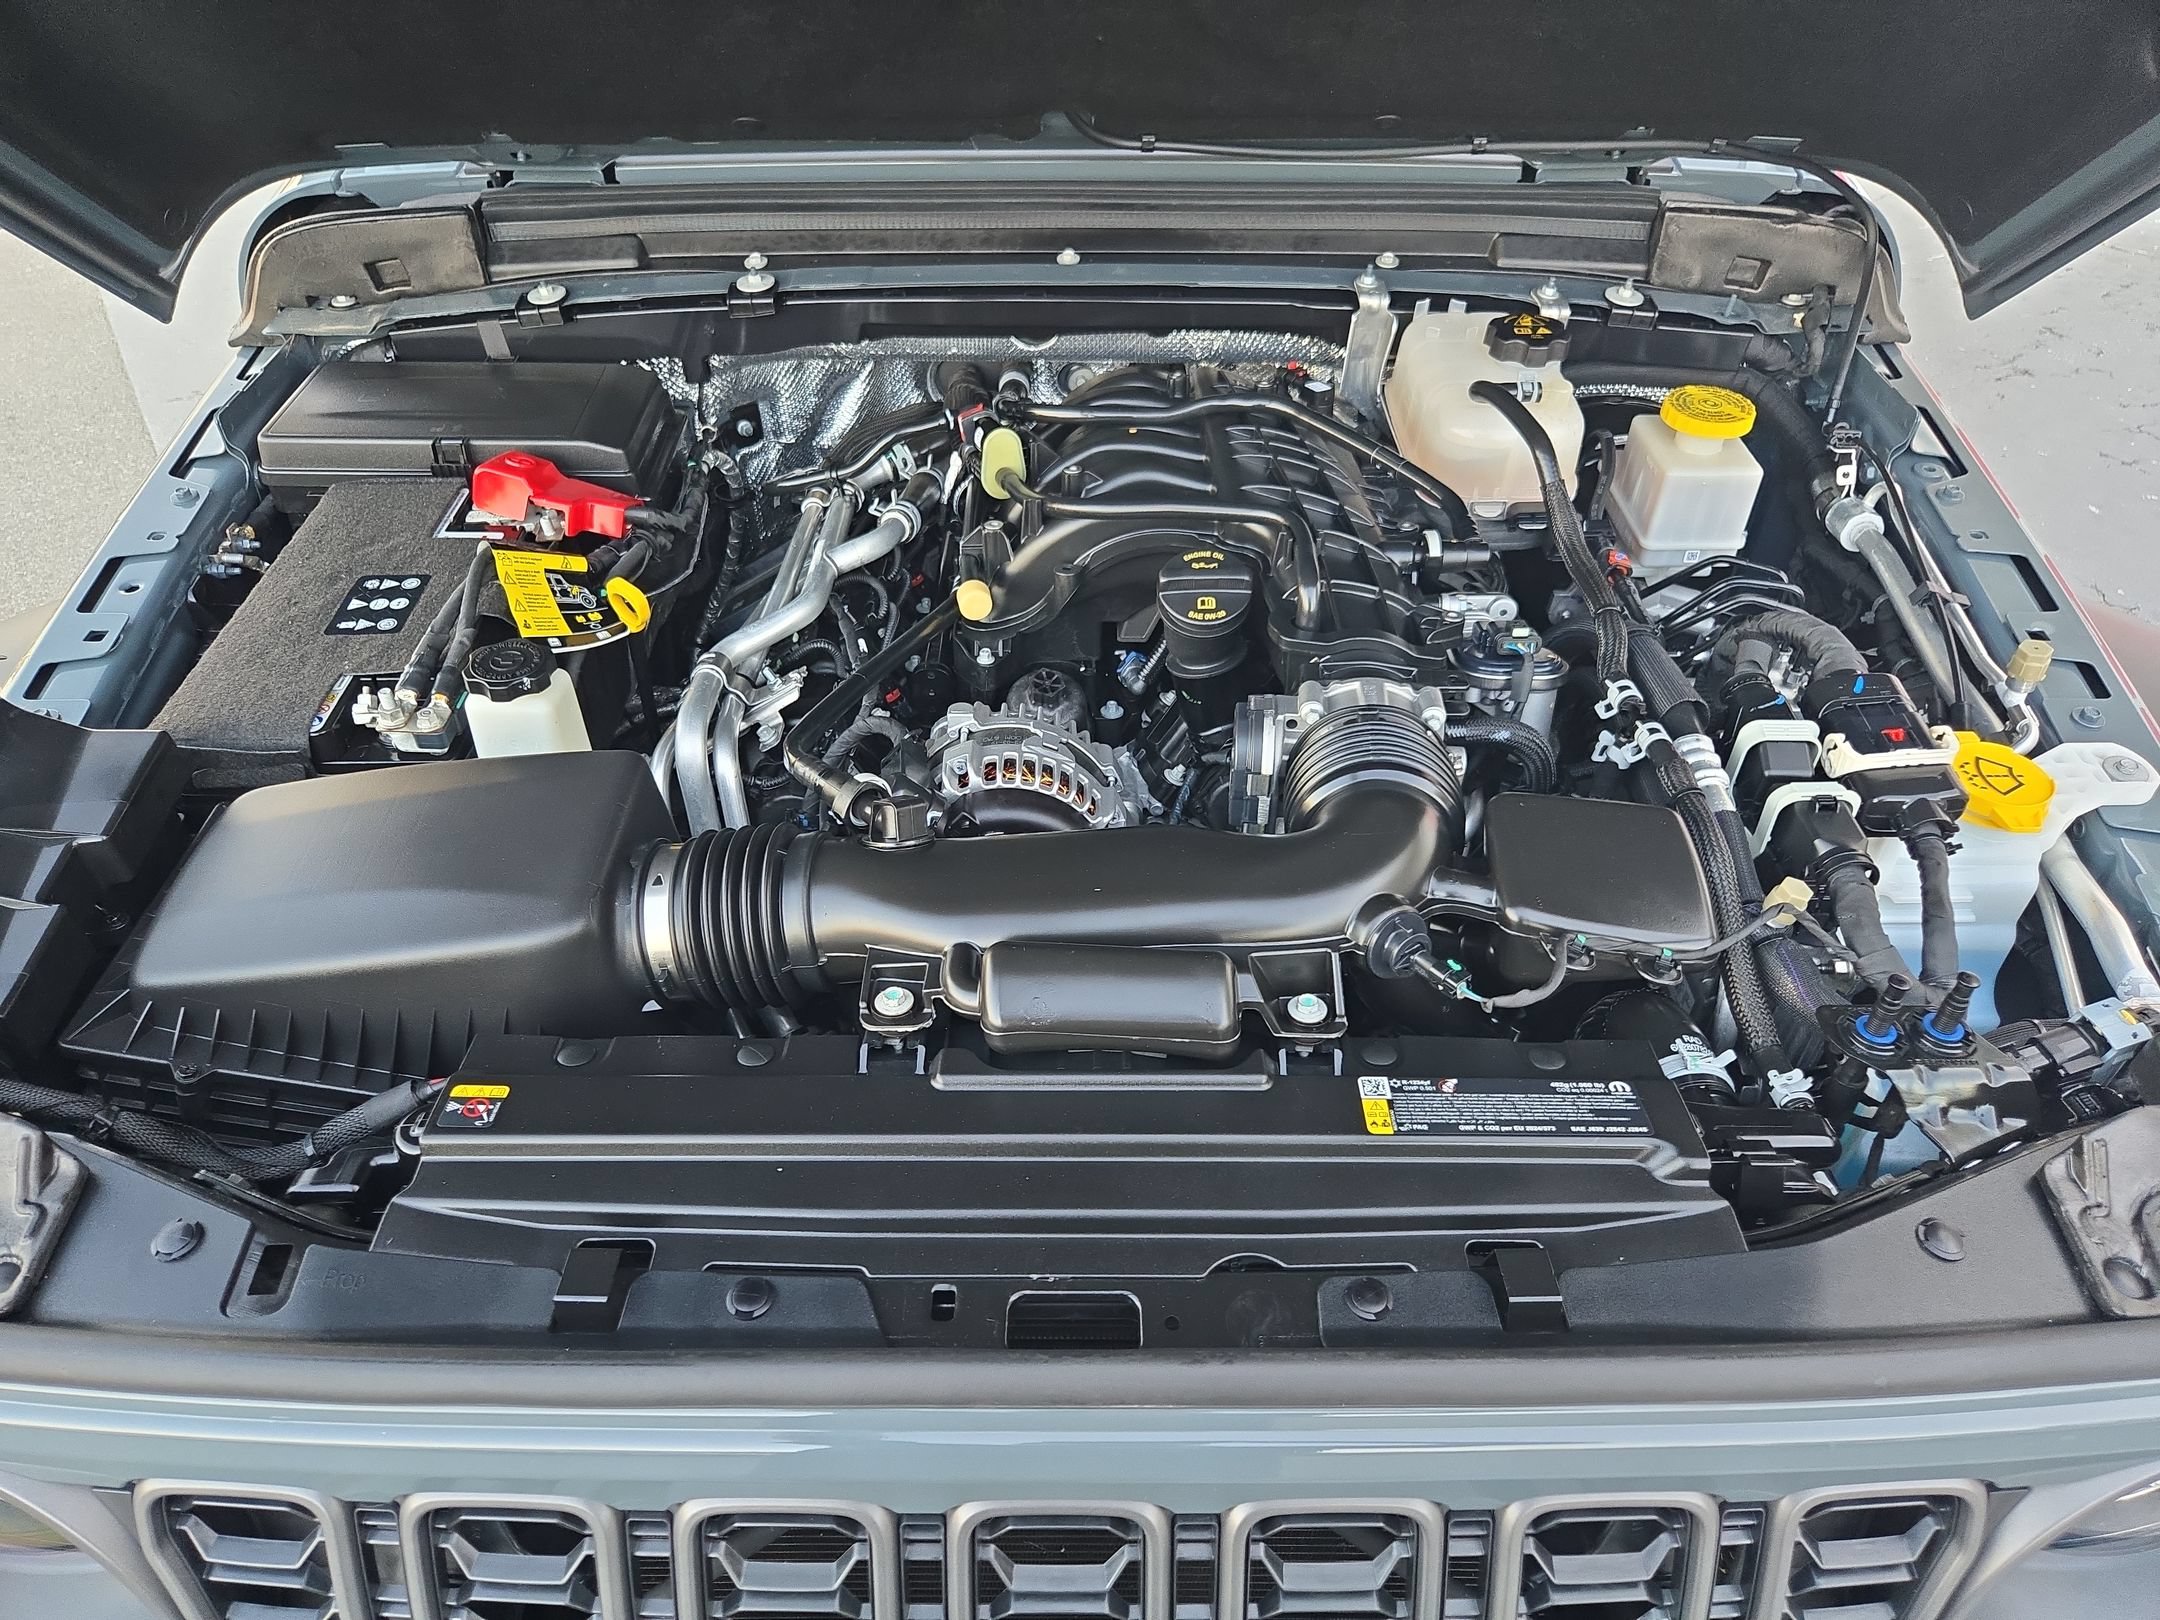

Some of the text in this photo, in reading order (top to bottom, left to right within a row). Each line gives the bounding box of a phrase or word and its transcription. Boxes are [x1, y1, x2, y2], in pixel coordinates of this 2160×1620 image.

[1183, 551, 1225, 562] ENGINE OIL
[1188, 610, 1227, 621] SAE 0W-20
[1682, 1034, 1703, 1045] RAD
[322, 1268, 367, 1292] Prop
